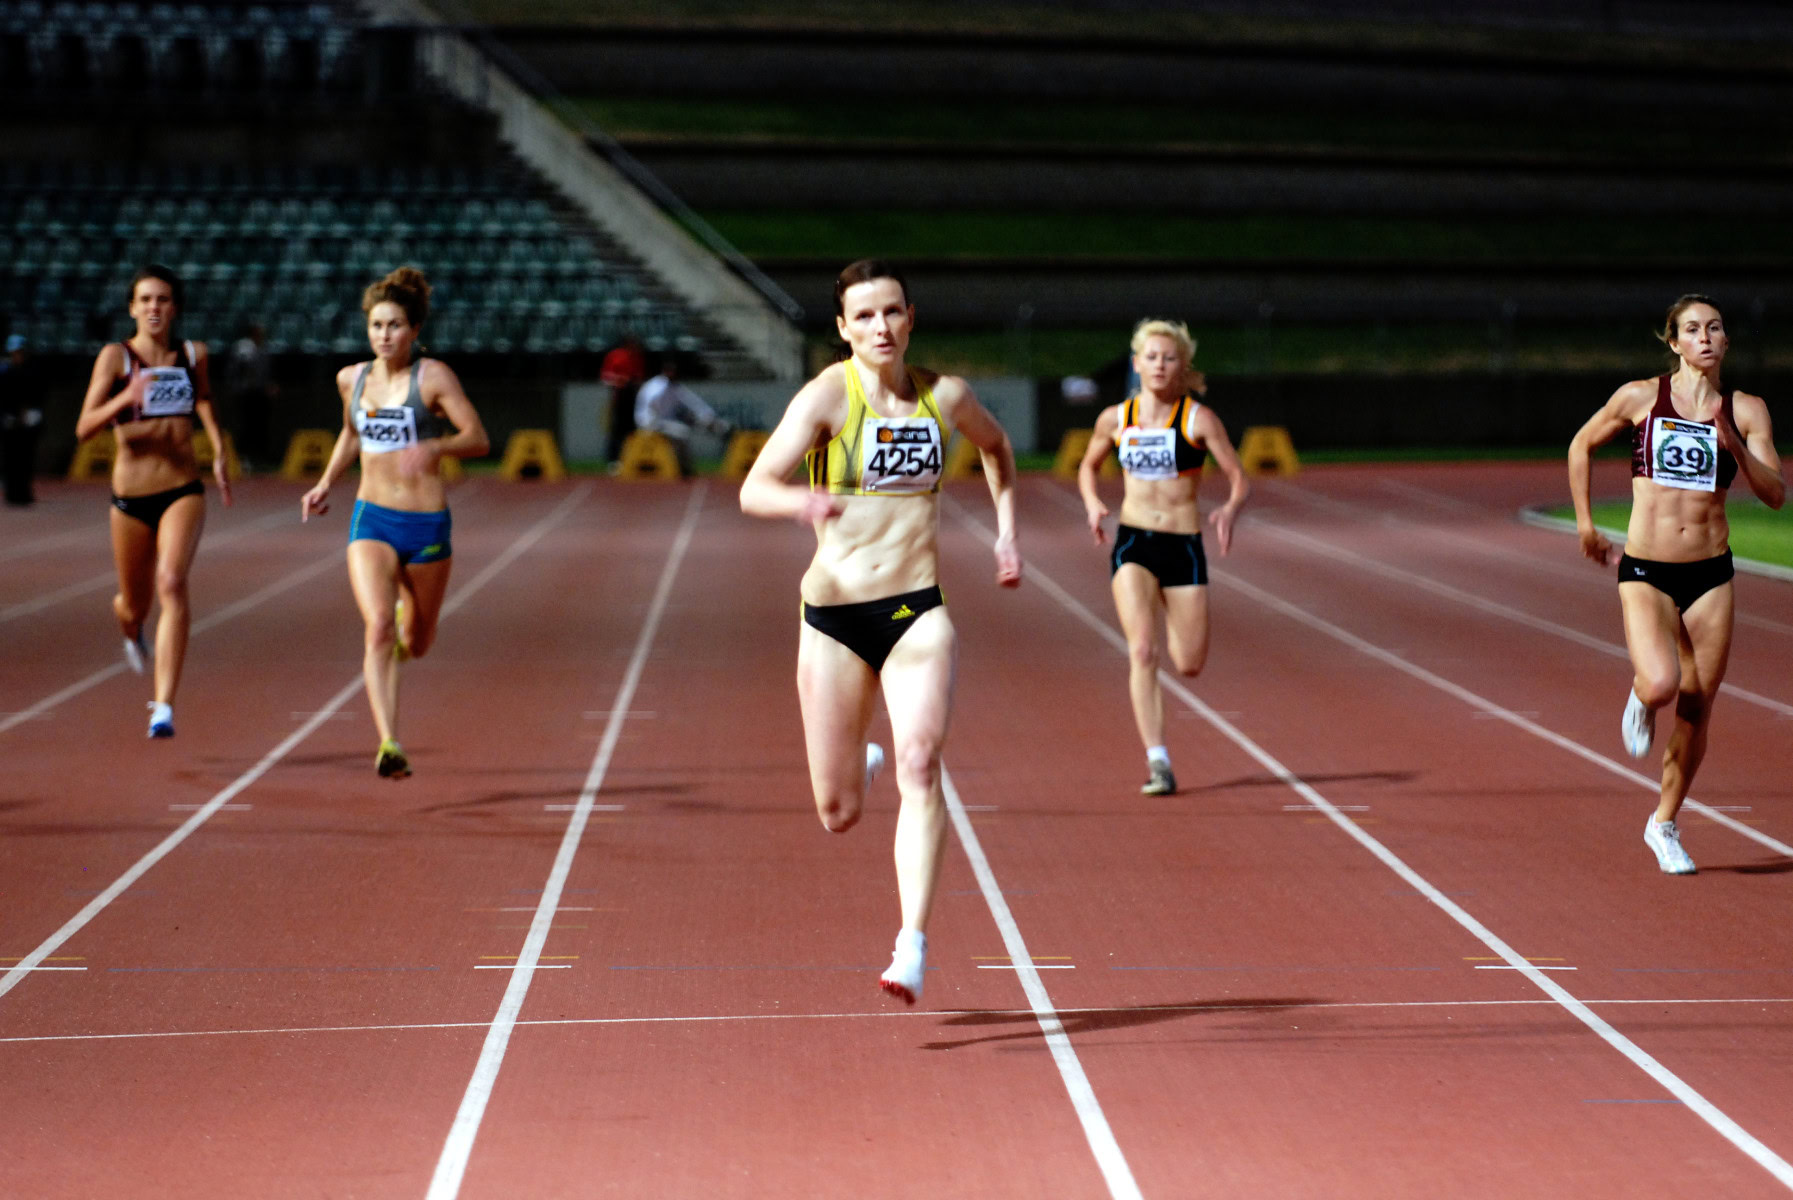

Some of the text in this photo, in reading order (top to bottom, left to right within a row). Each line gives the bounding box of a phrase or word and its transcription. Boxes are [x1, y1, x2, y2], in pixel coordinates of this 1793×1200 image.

[868, 445, 941, 476] 4254
[1122, 449, 1173, 472] 4268
[1664, 445, 1705, 470] 39
